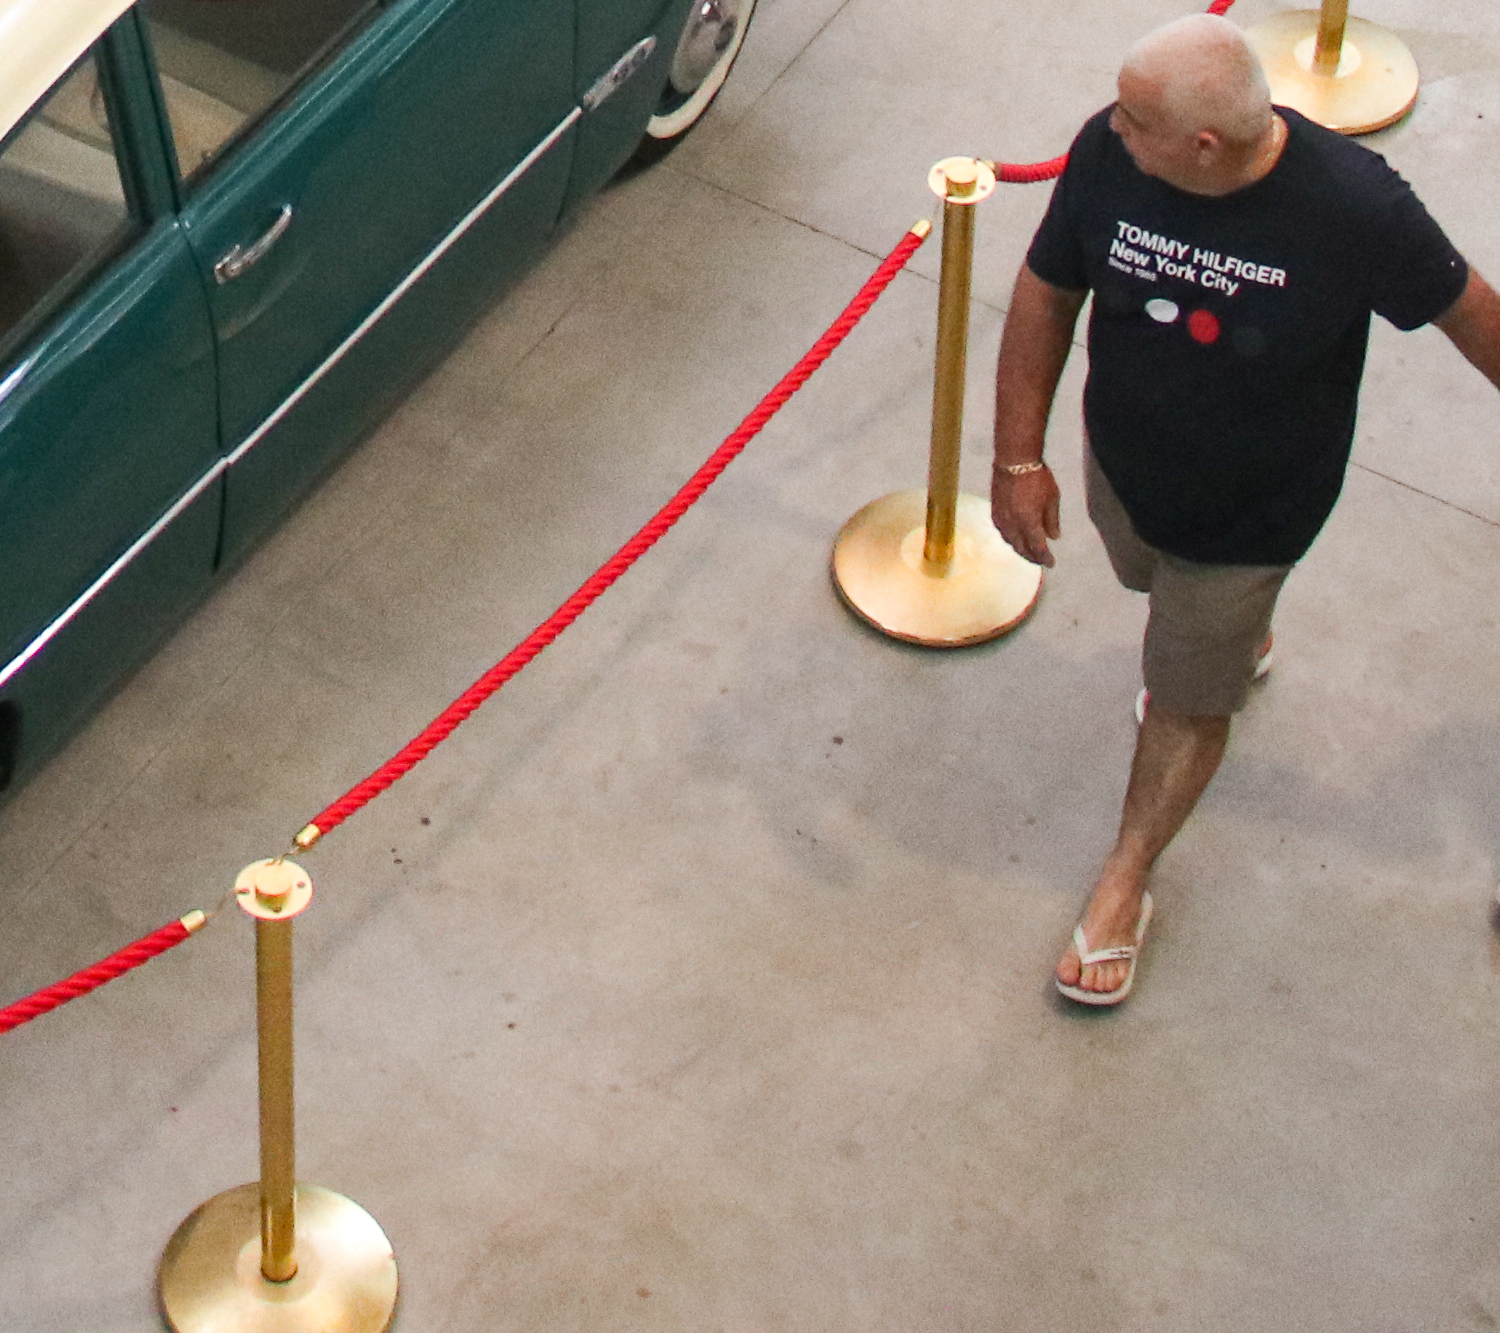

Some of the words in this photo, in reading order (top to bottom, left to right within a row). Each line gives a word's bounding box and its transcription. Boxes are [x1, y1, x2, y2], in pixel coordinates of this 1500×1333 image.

[1109, 238, 1150, 268] New
[1155, 255, 1197, 283] York
[1200, 268, 1239, 296] City
[1117, 220, 1190, 260] TOMMY
[1193, 247, 1287, 287] HILFIGER
